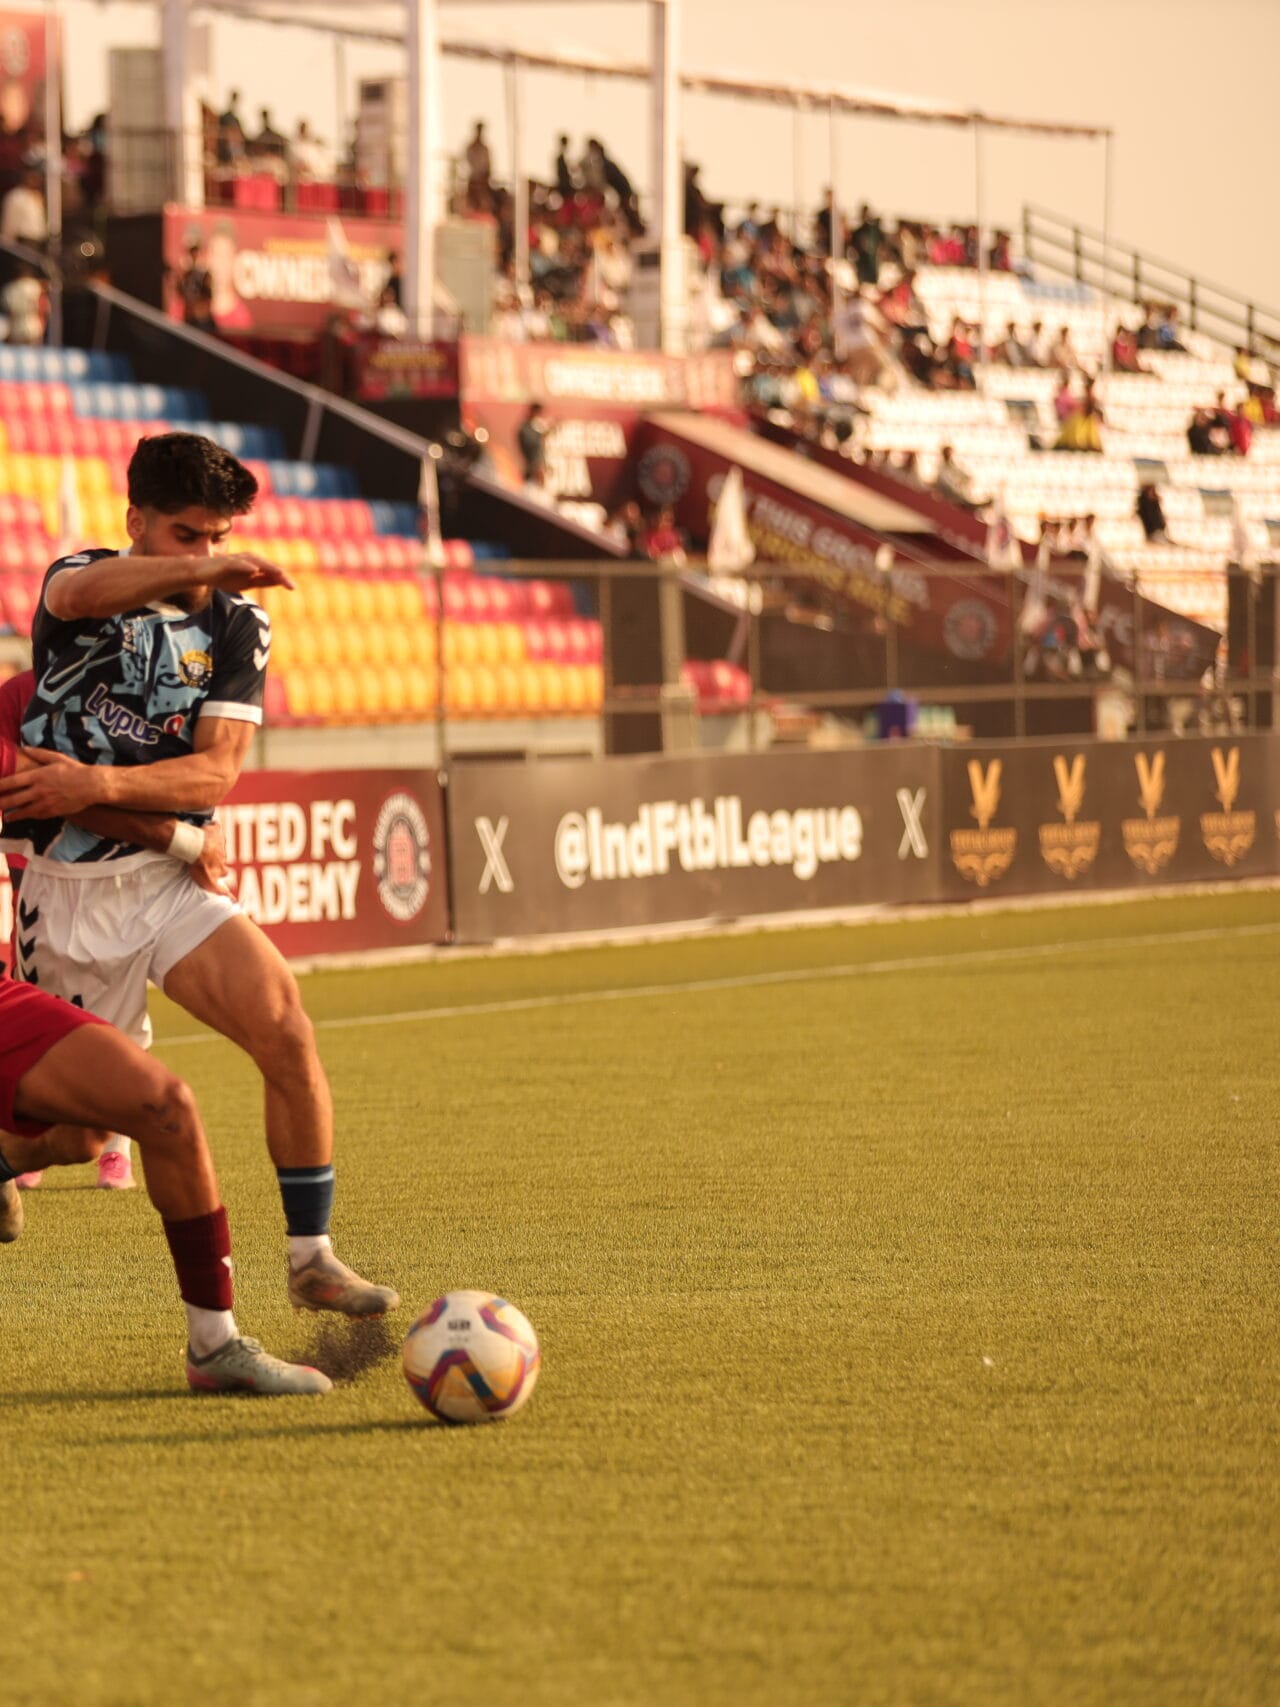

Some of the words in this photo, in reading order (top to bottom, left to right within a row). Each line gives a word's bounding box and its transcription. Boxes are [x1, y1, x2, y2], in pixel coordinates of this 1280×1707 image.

[216, 802, 308, 864] ITED
[310, 799, 358, 860] FC
[227, 860, 361, 926] ADEMY
